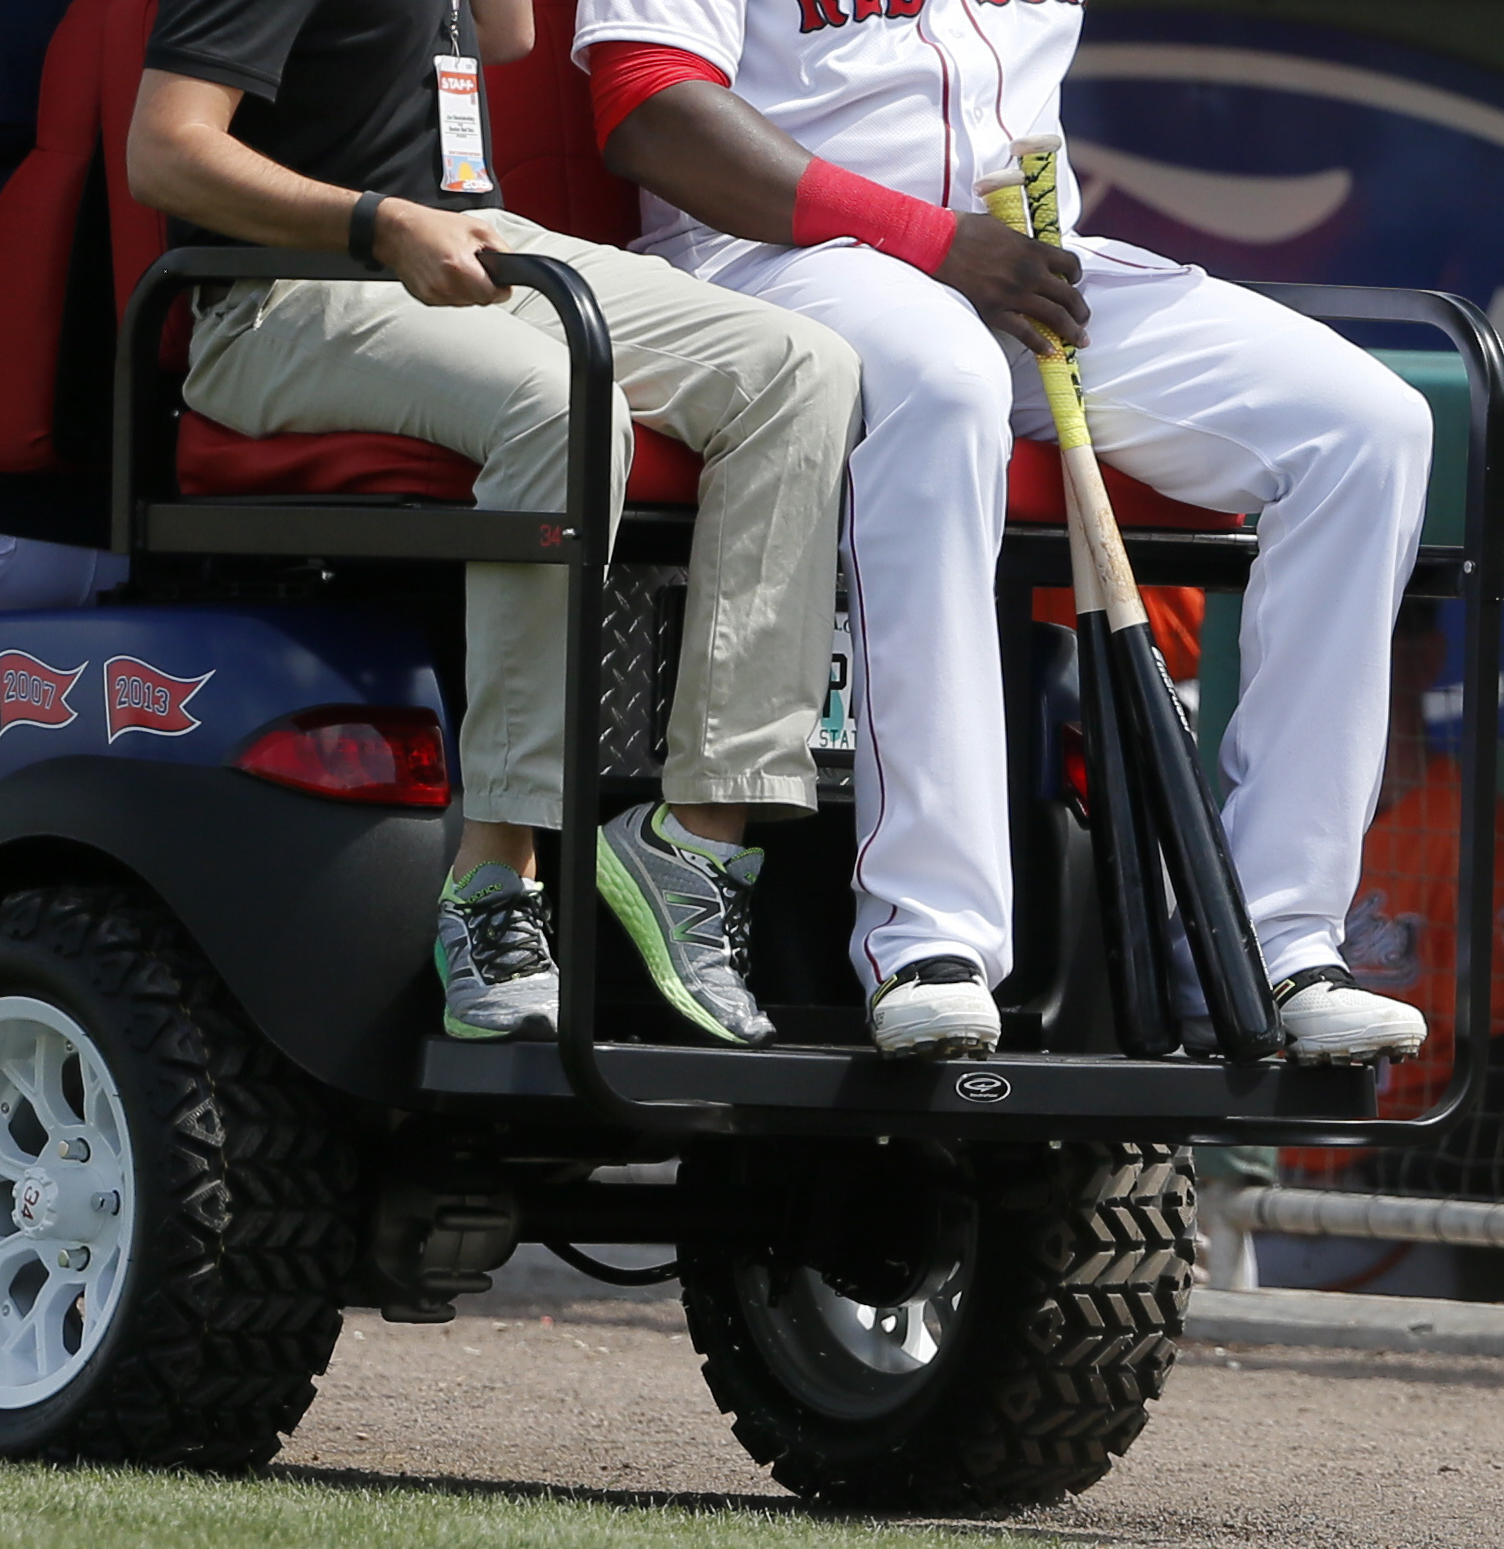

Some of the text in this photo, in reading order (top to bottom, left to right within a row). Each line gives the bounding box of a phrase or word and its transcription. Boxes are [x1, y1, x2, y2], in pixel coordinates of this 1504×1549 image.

[440, 76, 476, 91] STAFF
[539, 524, 563, 547] 34
[3, 670, 56, 710] 2007
[115, 675, 171, 716] 2013
[21, 1186, 39, 1220] 34
